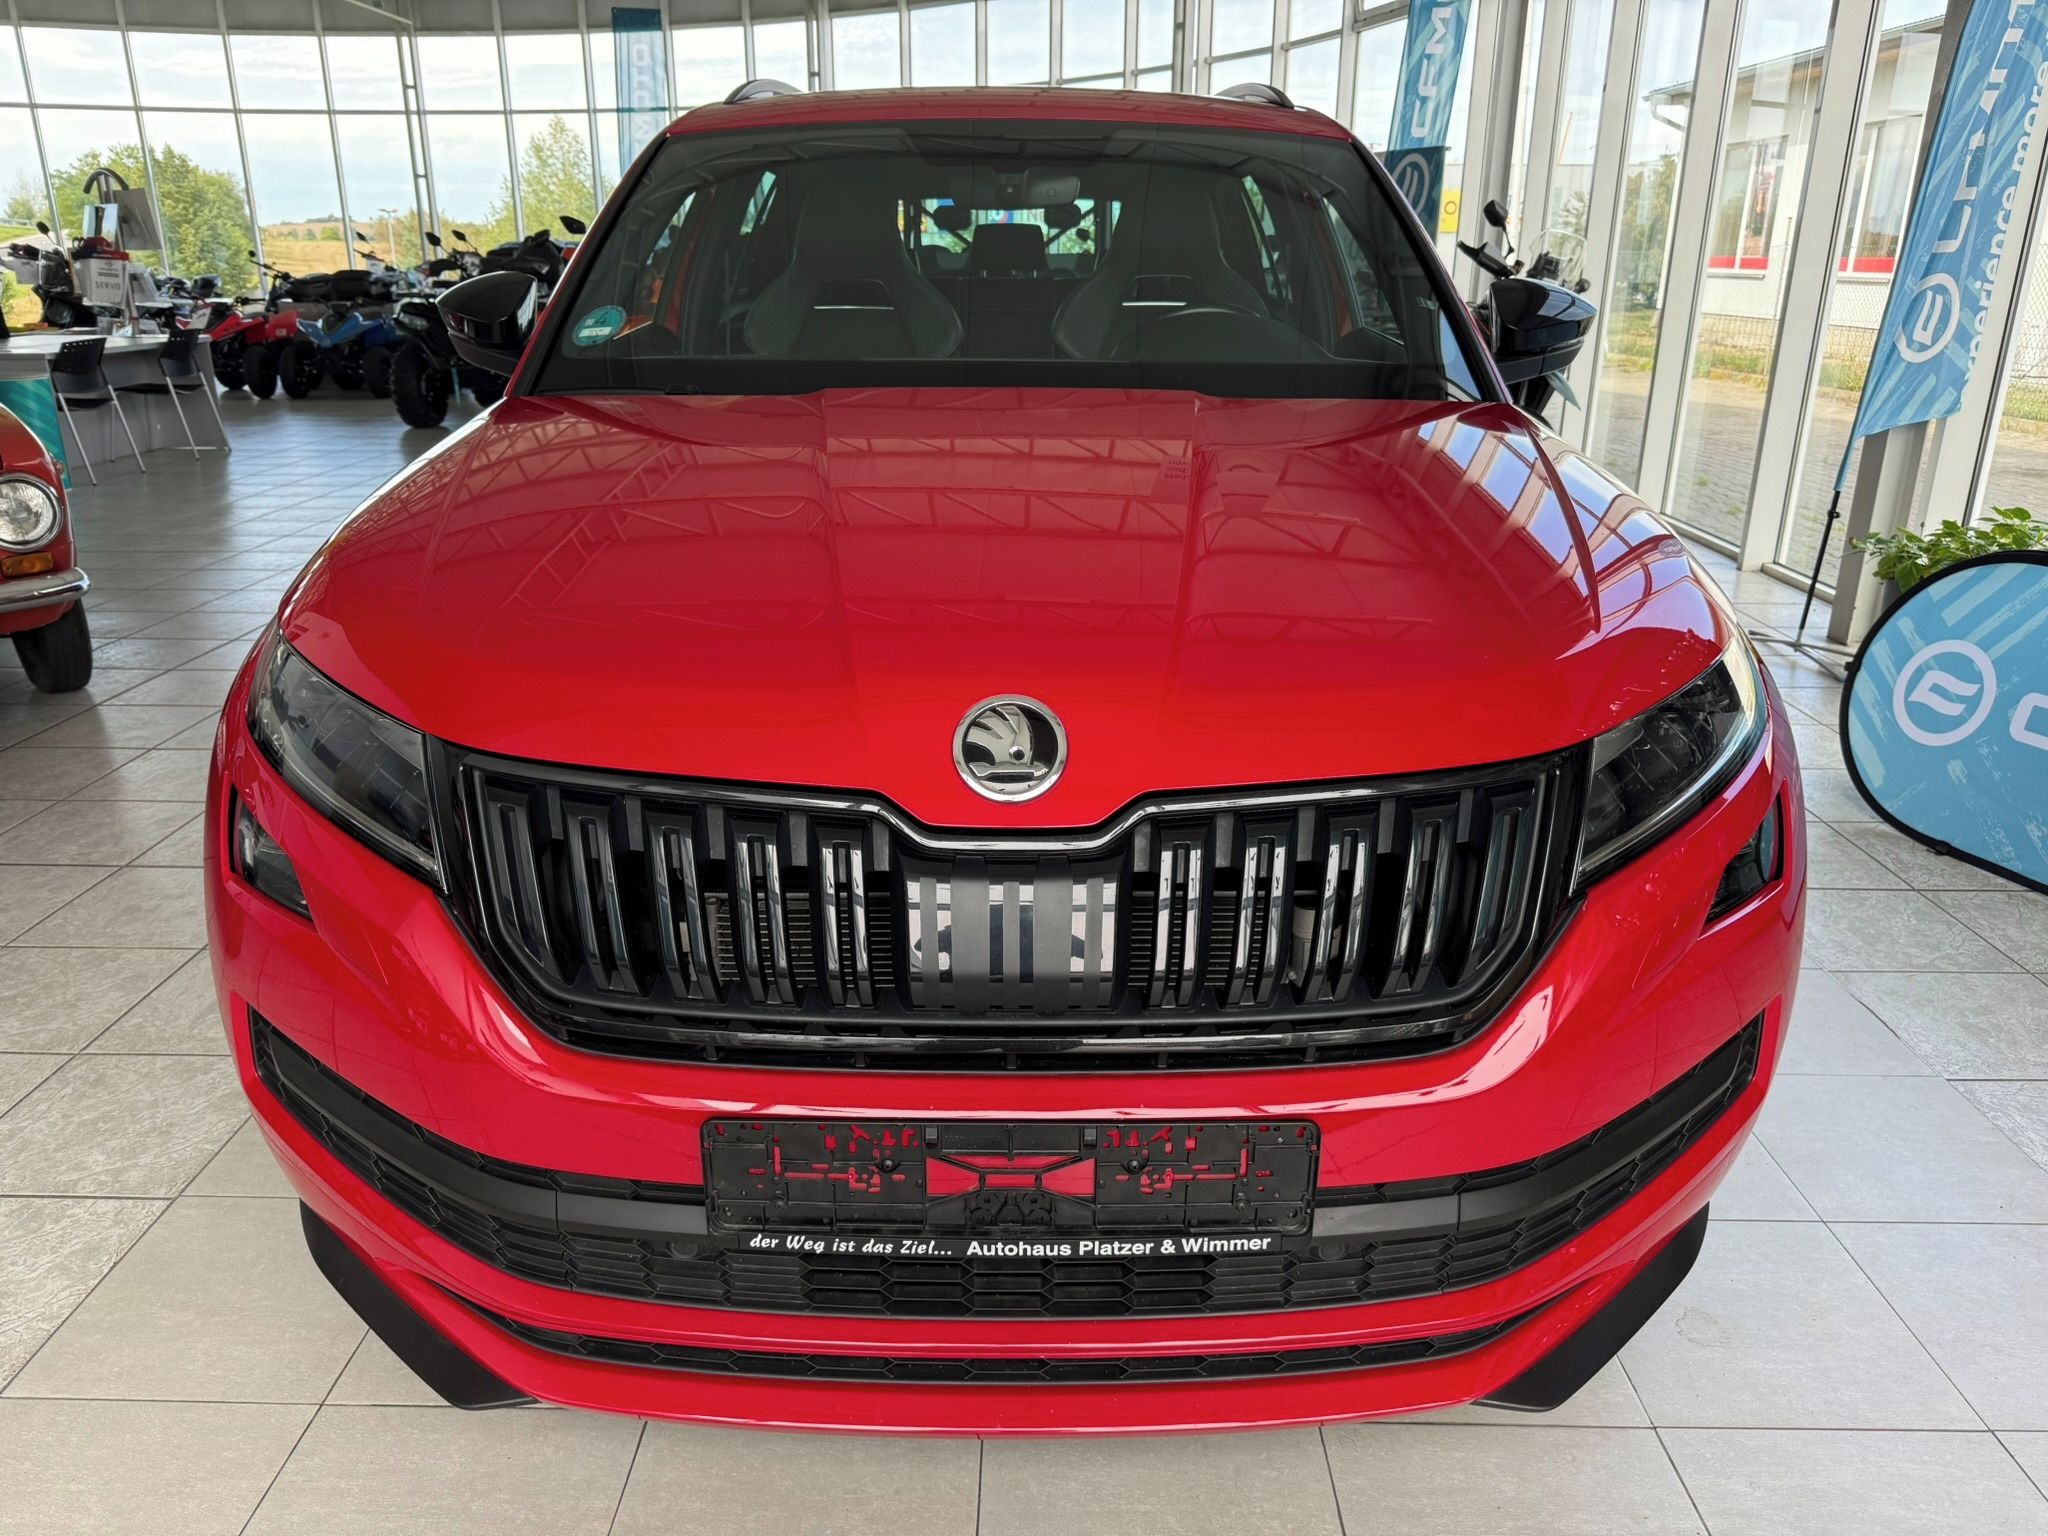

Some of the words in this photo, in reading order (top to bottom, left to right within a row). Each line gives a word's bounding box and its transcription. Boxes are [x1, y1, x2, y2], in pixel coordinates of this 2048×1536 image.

[1410, 0, 1453, 138] CFM
[749, 1234, 779, 1248] der
[786, 1235, 826, 1254] Weg
[832, 1238, 856, 1252] ist
[862, 1238, 894, 1254] das
[900, 1240, 952, 1255] Ziel...
[966, 1240, 1072, 1257] Autohaus
[1079, 1240, 1154, 1256] Platzer
[1160, 1239, 1176, 1254] &
[1181, 1236, 1272, 1253] Wimmer
